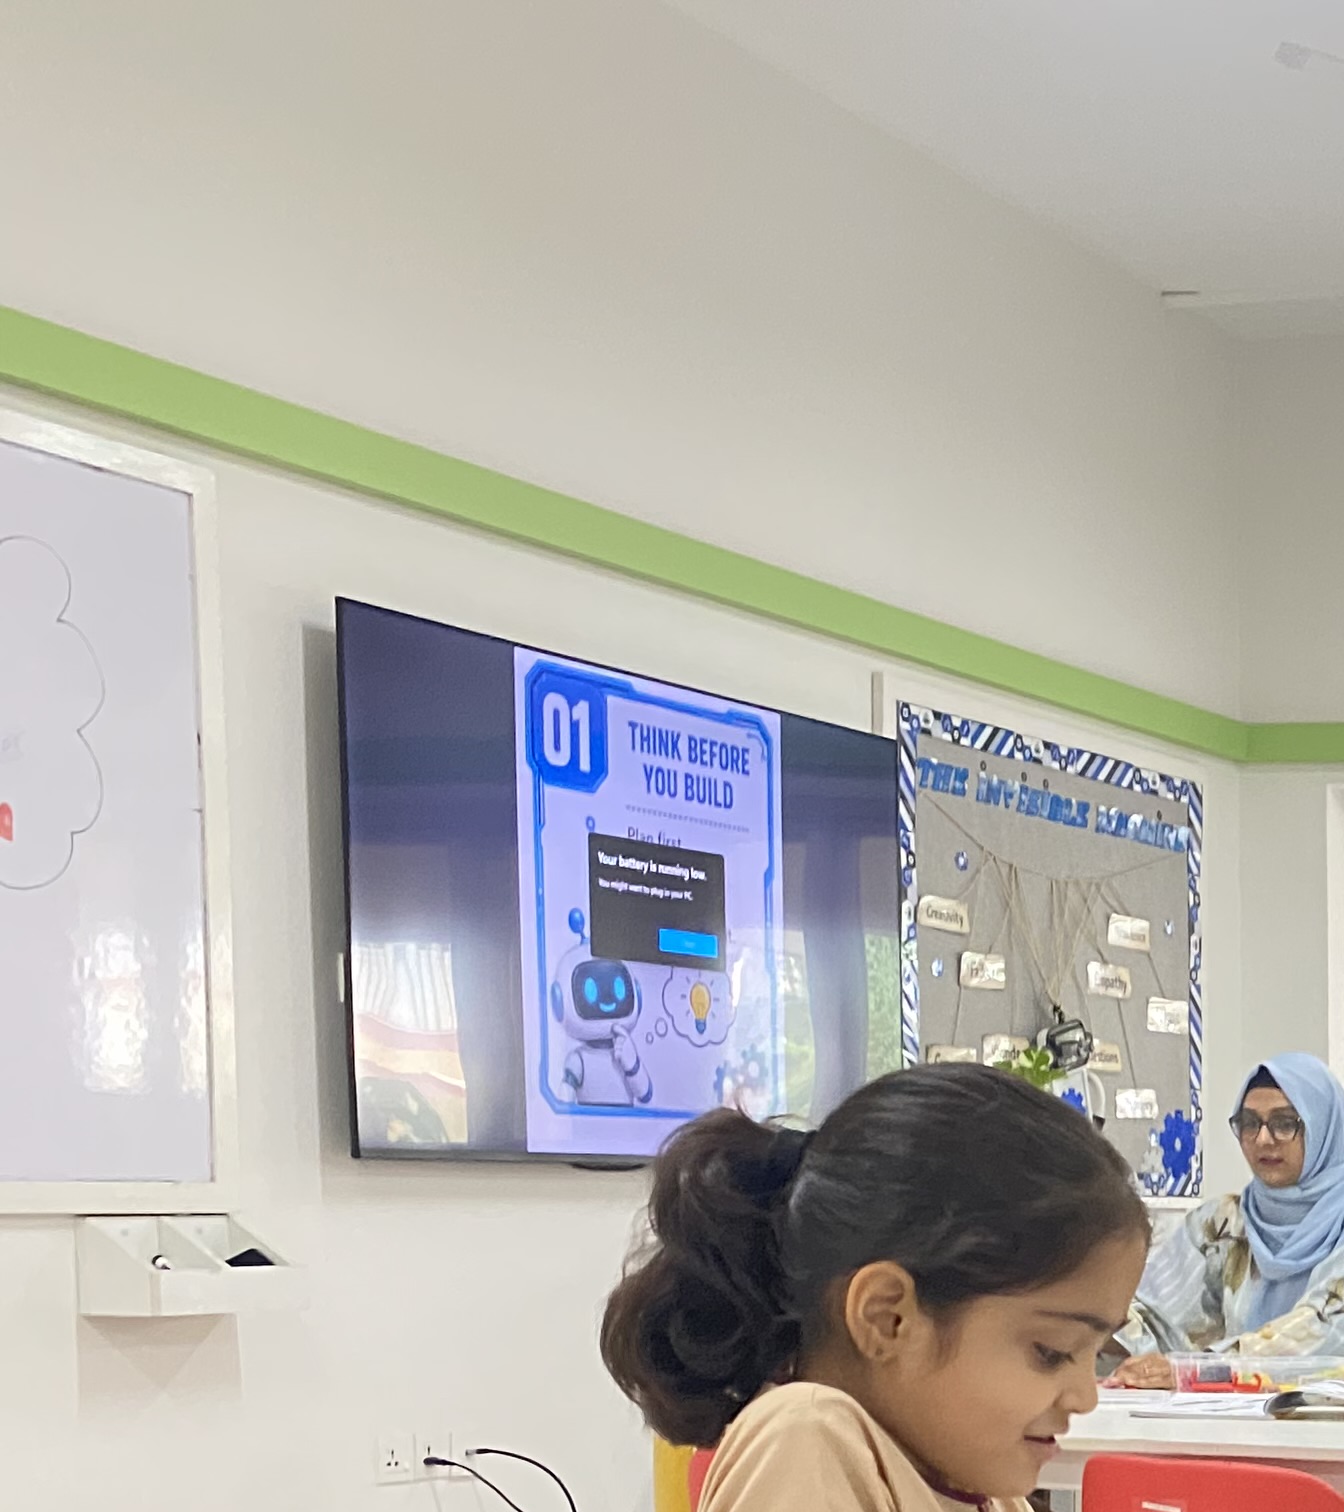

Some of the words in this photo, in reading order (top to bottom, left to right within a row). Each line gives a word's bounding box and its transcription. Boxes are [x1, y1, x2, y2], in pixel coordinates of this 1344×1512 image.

[542, 691, 591, 774] 01
[628, 720, 682, 762] THINK
[688, 734, 750, 776] BEFORE
[643, 763, 678, 798] YOU
[684, 772, 734, 809] BUILD
[917, 757, 969, 797] THE
[597, 850, 618, 866] Your
[618, 854, 649, 875] battery
[650, 859, 658, 873] is
[658, 863, 690, 881] running
